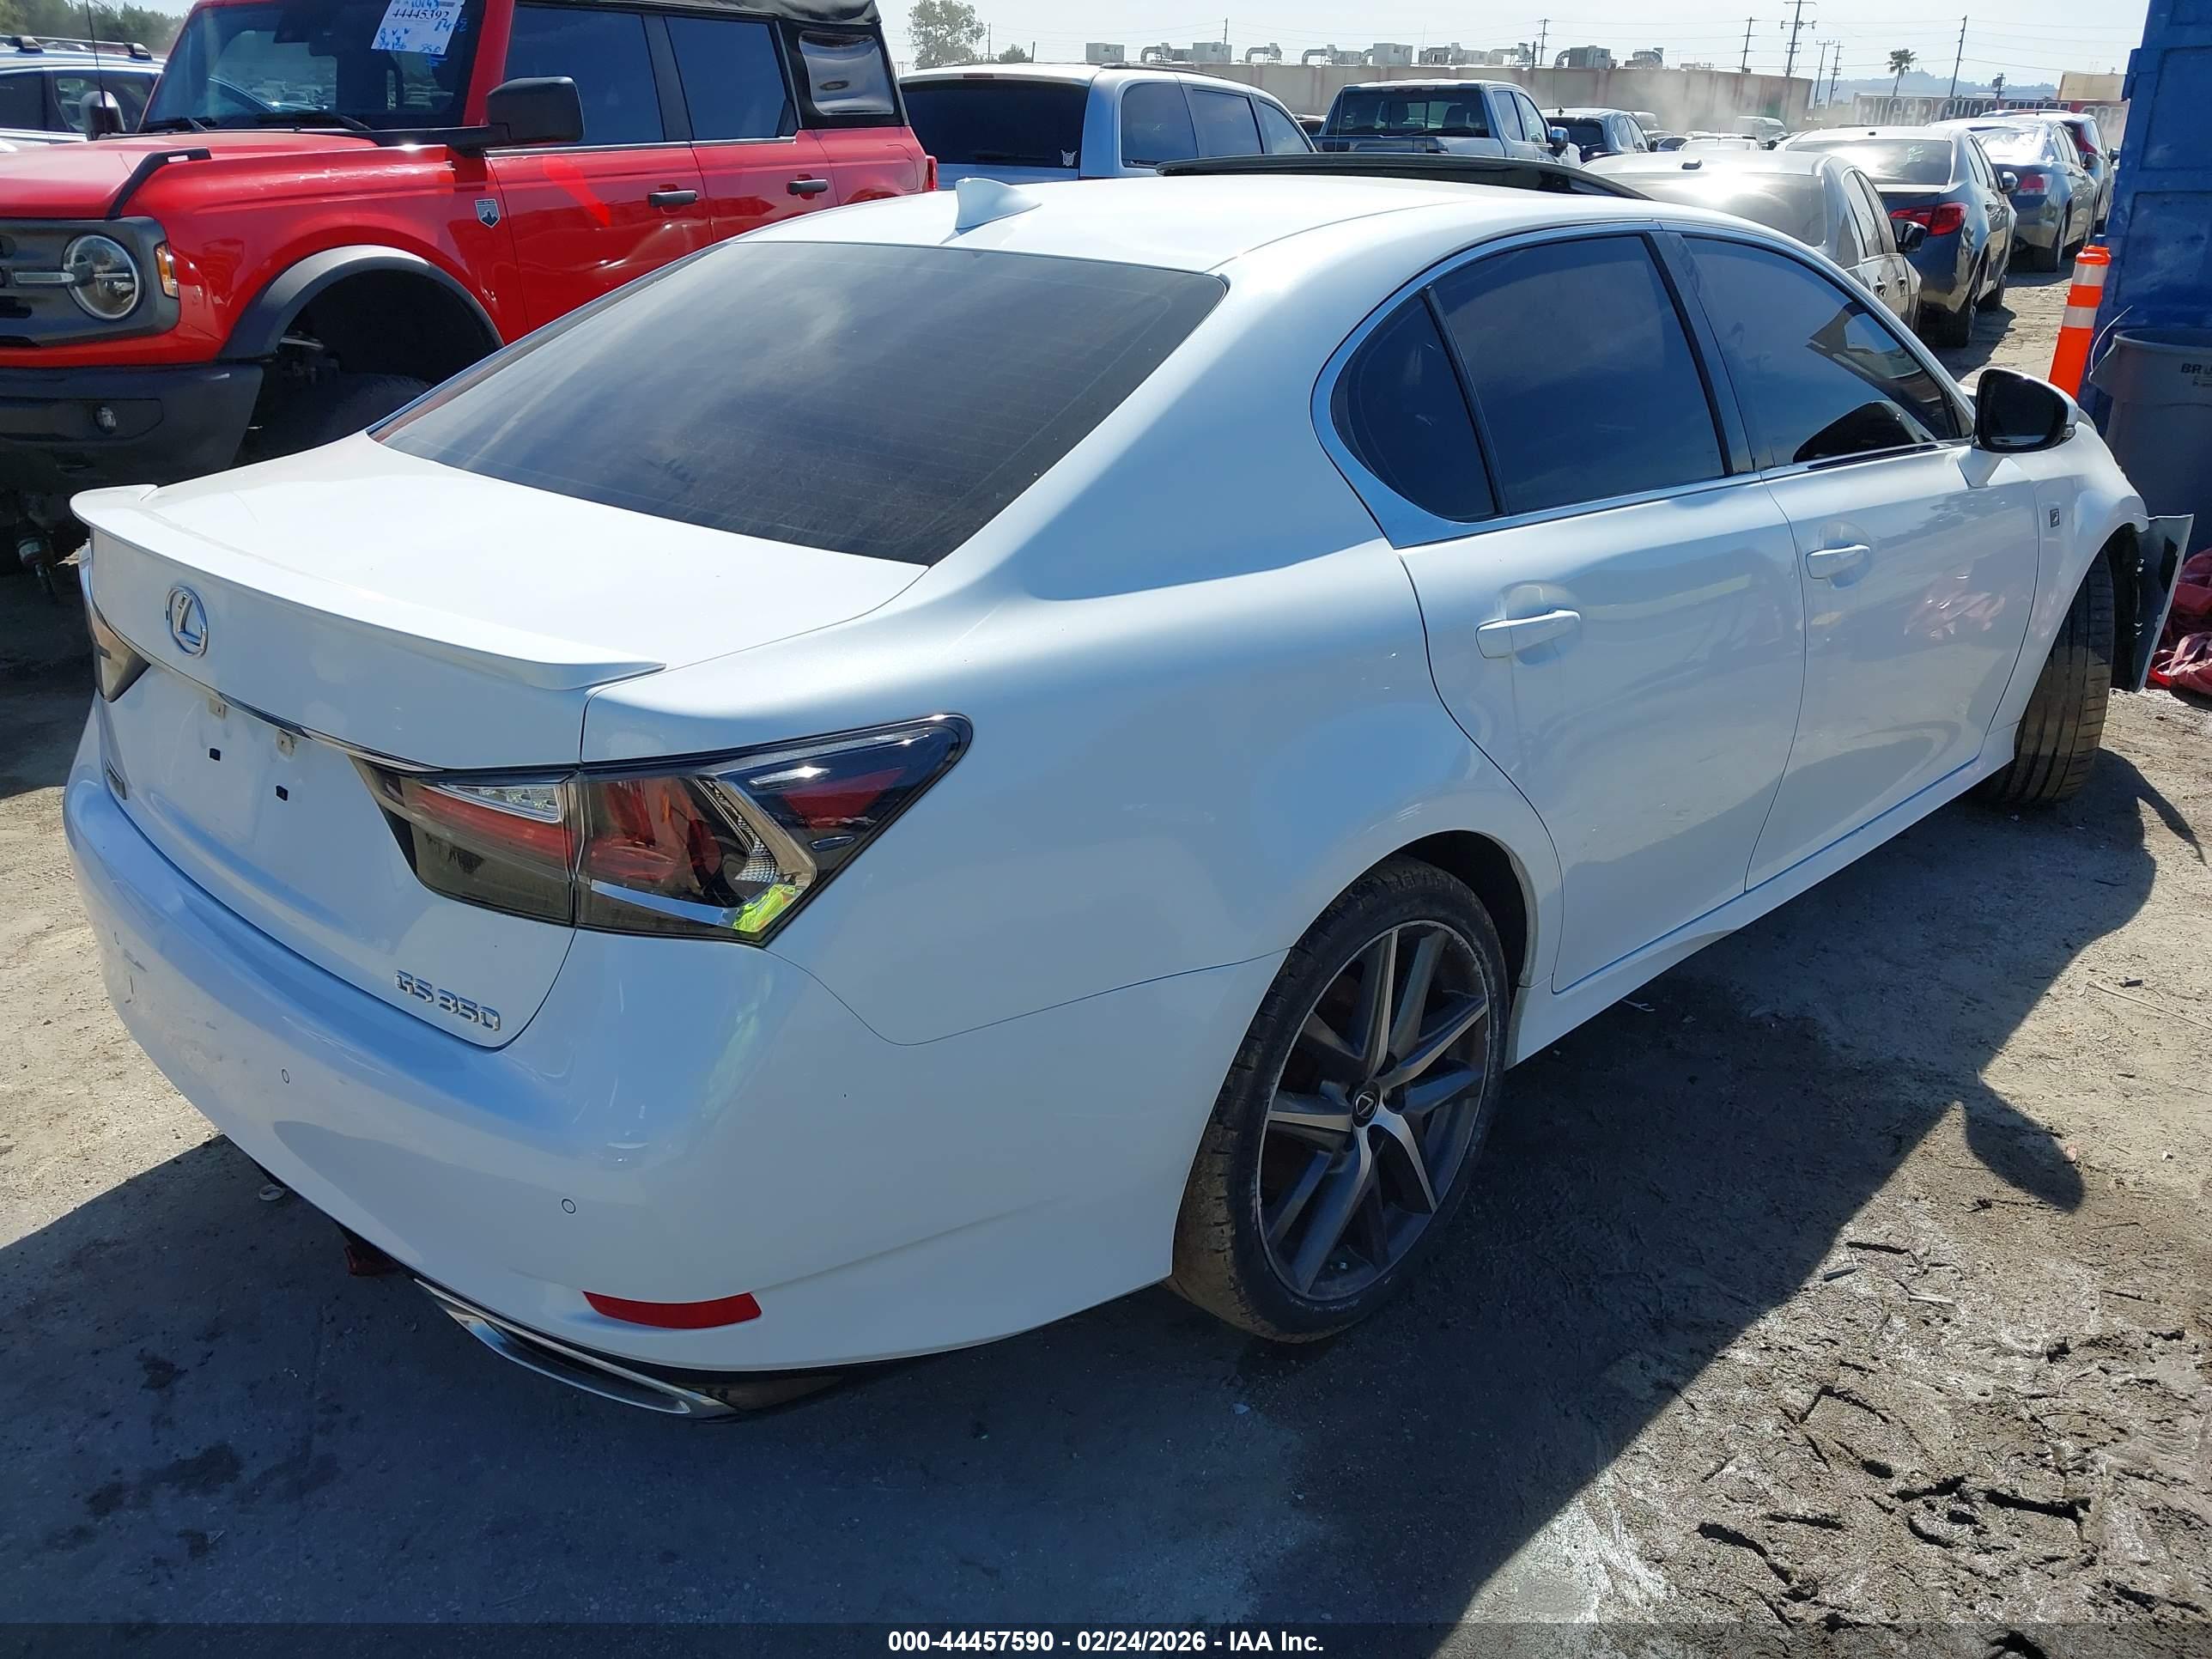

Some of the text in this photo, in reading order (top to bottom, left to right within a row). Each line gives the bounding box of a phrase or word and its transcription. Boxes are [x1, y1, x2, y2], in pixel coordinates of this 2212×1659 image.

[392, 8, 449, 21] 44445392
[394, 969, 501, 1031] GS 350
